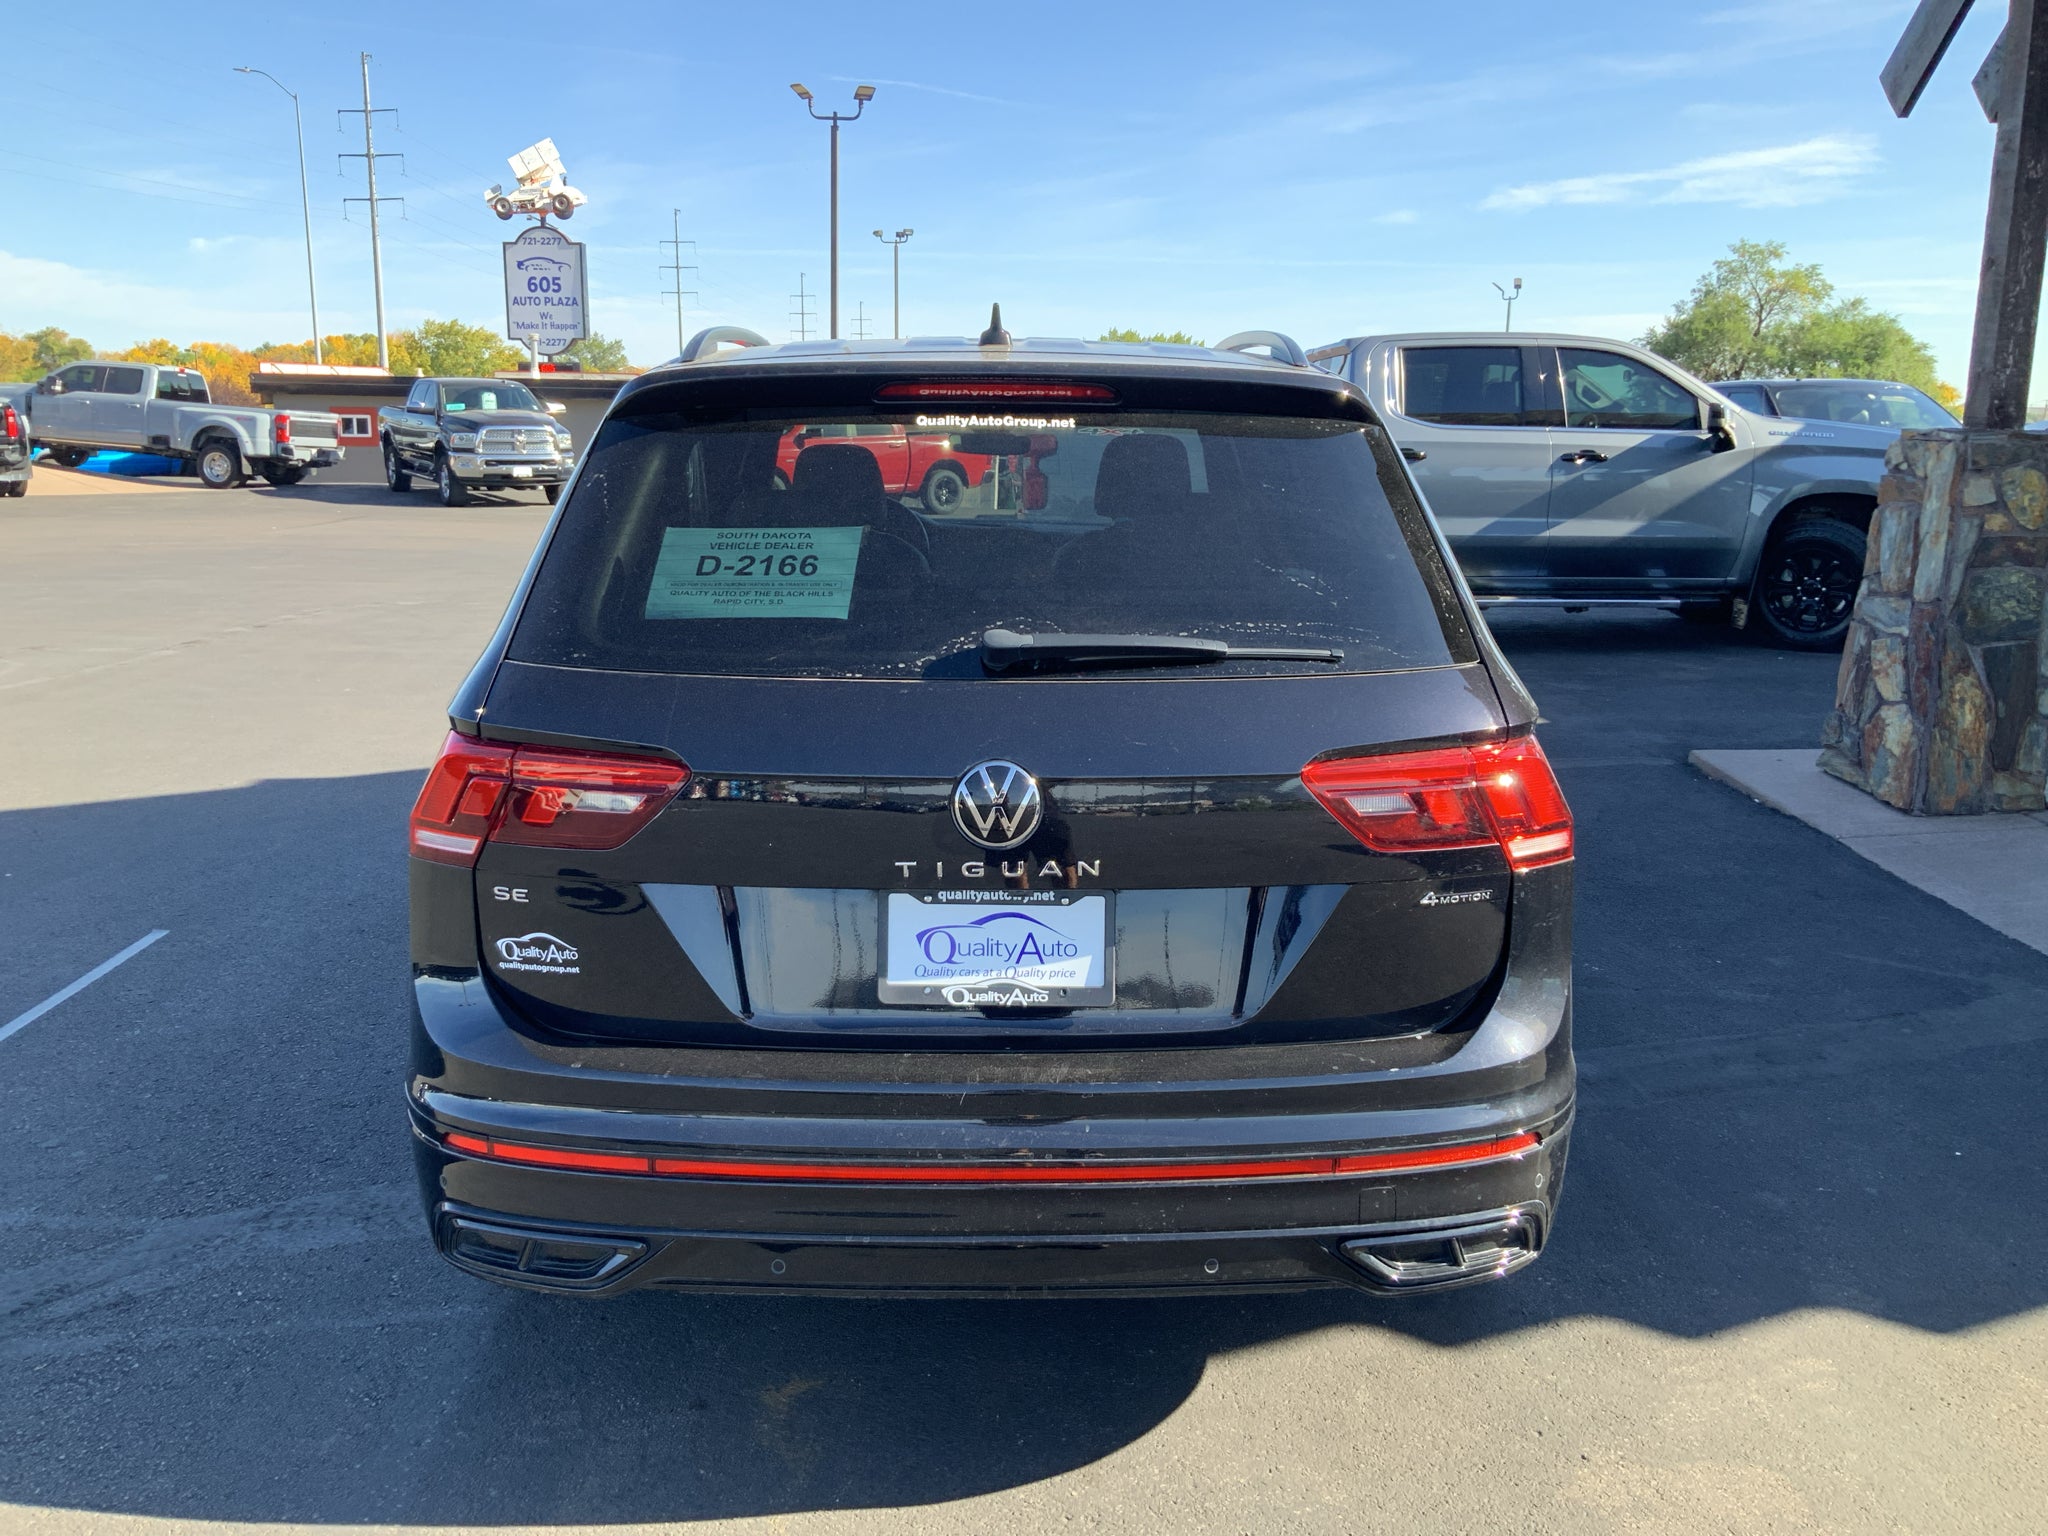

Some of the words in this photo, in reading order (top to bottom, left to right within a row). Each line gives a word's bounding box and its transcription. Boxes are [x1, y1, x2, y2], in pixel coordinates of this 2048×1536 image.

[522, 237, 562, 246] 721-2277
[527, 276, 562, 293] 605
[512, 296, 541, 306] AUTO
[544, 296, 579, 307] PLAZA
[539, 311, 553, 320] We
[916, 415, 1076, 429] QualityAutoGroup.net
[716, 532, 758, 540] SOUTH
[762, 532, 812, 540] DAKOTA
[710, 542, 761, 550] VEHICLE
[764, 542, 814, 550] DEALER
[696, 554, 819, 577] D-2166
[895, 860, 1101, 878] TIGUAN
[493, 886, 530, 903] SE
[499, 961, 580, 974] qualityautogroup.net
[914, 963, 957, 979] Quality
[959, 967, 980, 978] cars
[982, 967, 995, 978] at
[996, 969, 1002, 978] a
[1004, 965, 1048, 980] Quality
[1048, 967, 1076, 979] price
